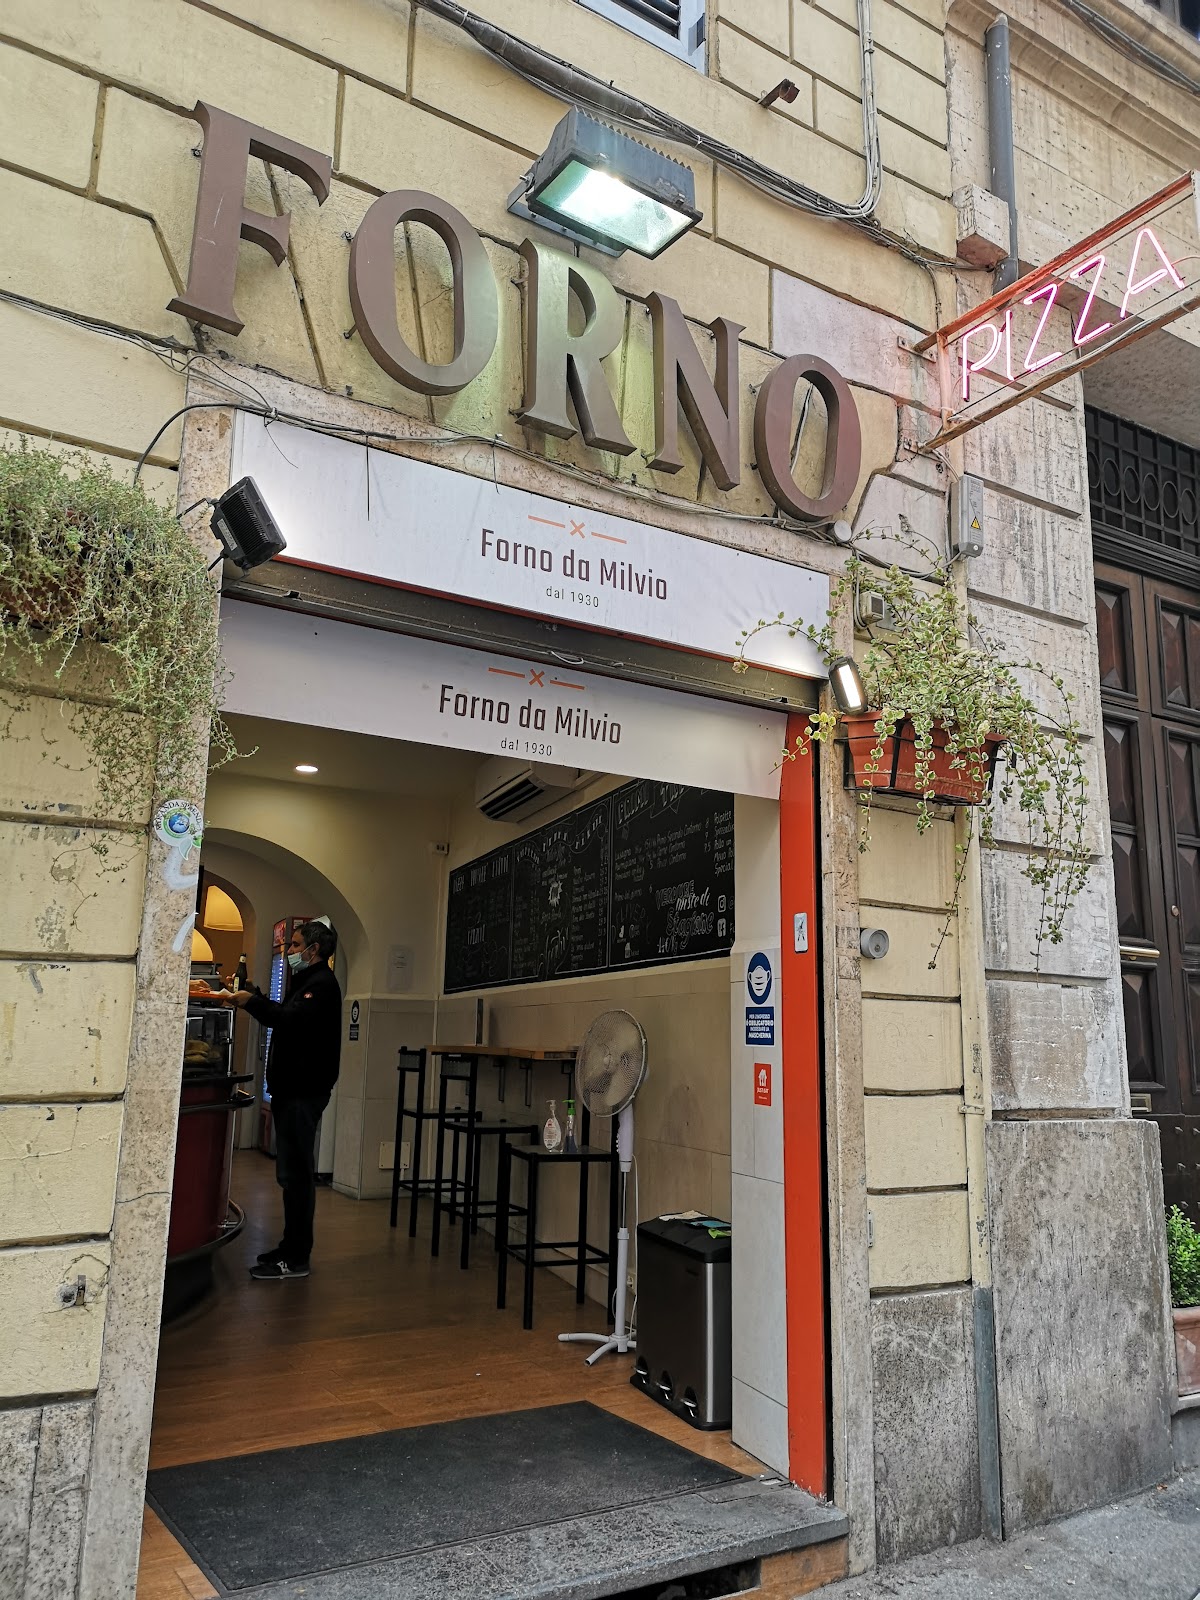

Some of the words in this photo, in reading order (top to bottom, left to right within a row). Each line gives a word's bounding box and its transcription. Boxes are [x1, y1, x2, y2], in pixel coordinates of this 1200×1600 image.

[167, 100, 862, 521] FORNO
[962, 228, 1185, 402] PIZZA
[481, 528, 552, 573] Forno
[562, 549, 590, 582] da
[600, 558, 667, 600] Milvio
[546, 586, 564, 600] dal
[570, 591, 599, 608] 1930
[439, 684, 510, 724] Forno
[519, 699, 546, 731] da
[555, 706, 621, 744] Milvio
[500, 738, 518, 750] dal
[524, 741, 552, 756] 1930
[700, 886, 710, 907] di
[749, 1019, 774, 1027] OBBLIGATORIO
[748, 1031, 772, 1039] MASCHERINA
